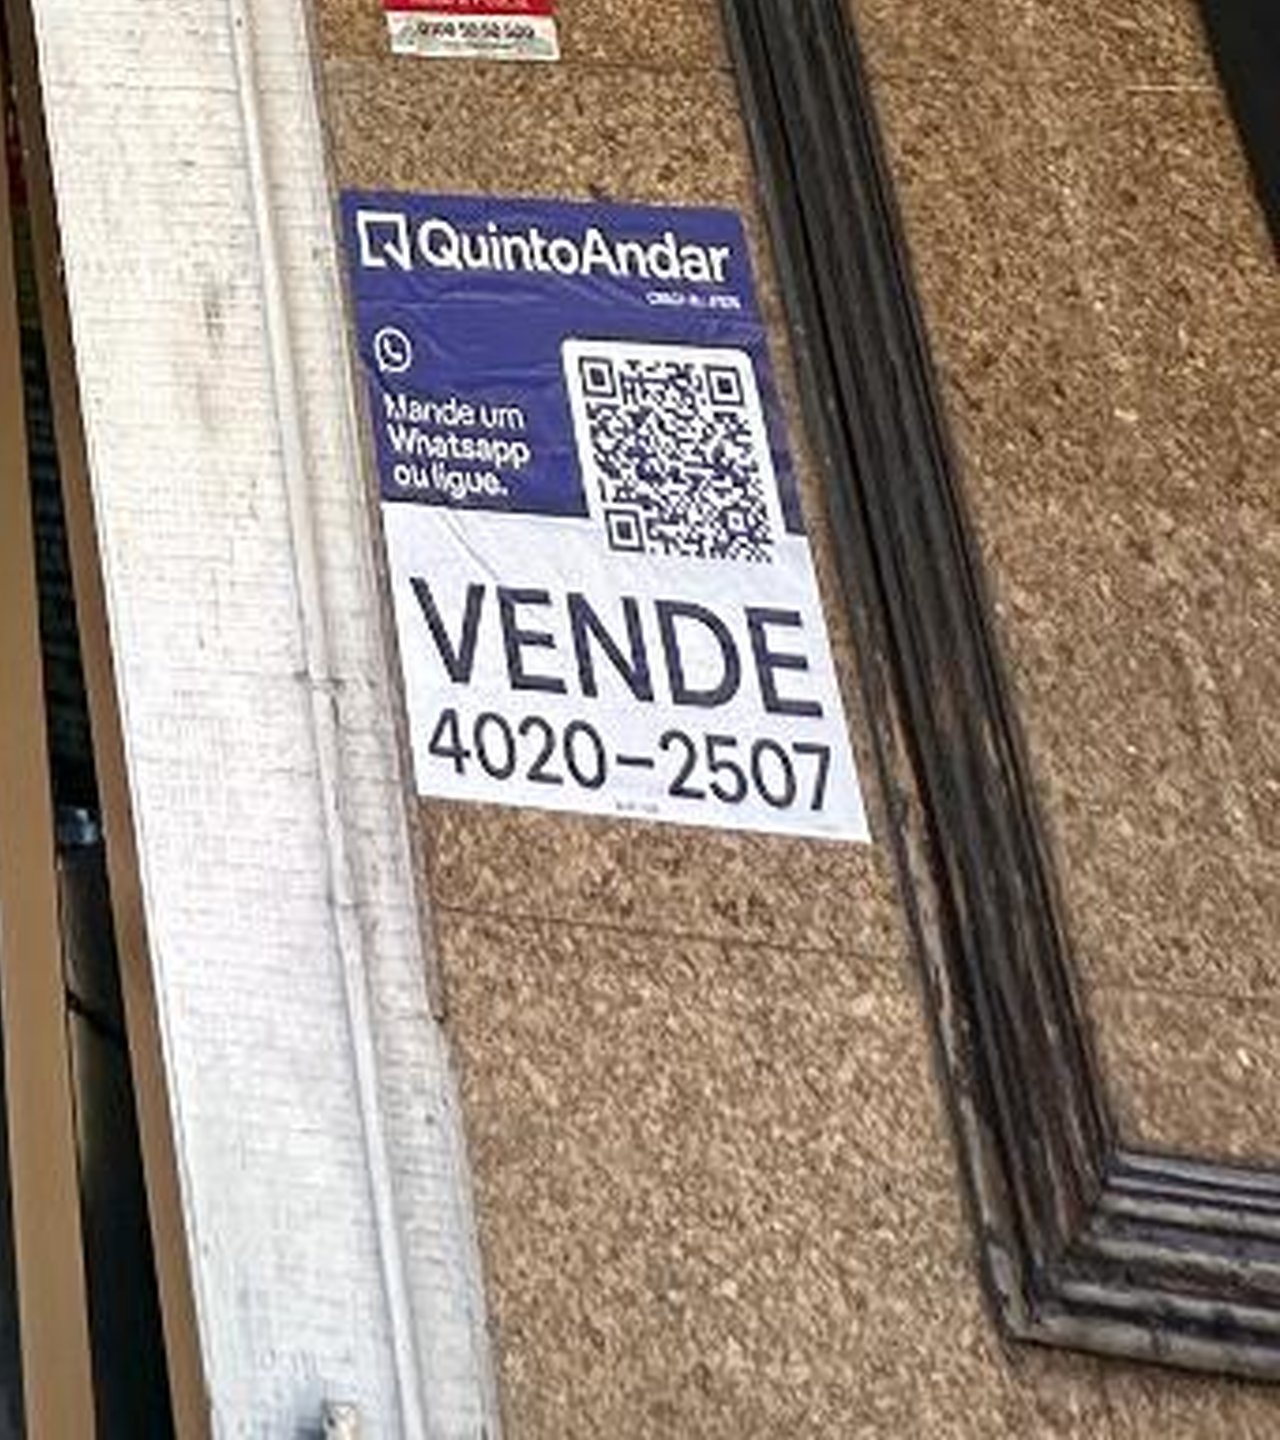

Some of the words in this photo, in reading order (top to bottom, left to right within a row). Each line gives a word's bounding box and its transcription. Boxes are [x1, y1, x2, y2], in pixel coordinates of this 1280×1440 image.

[417, 218, 730, 283] QuintoAndar
[480, 405, 525, 429] um
[386, 423, 531, 470] Whatsapp
[393, 464, 430, 488] ou
[431, 461, 509, 500] ligue.
[407, 576, 824, 719] VENDE
[427, 708, 832, 812] 4020-2507
